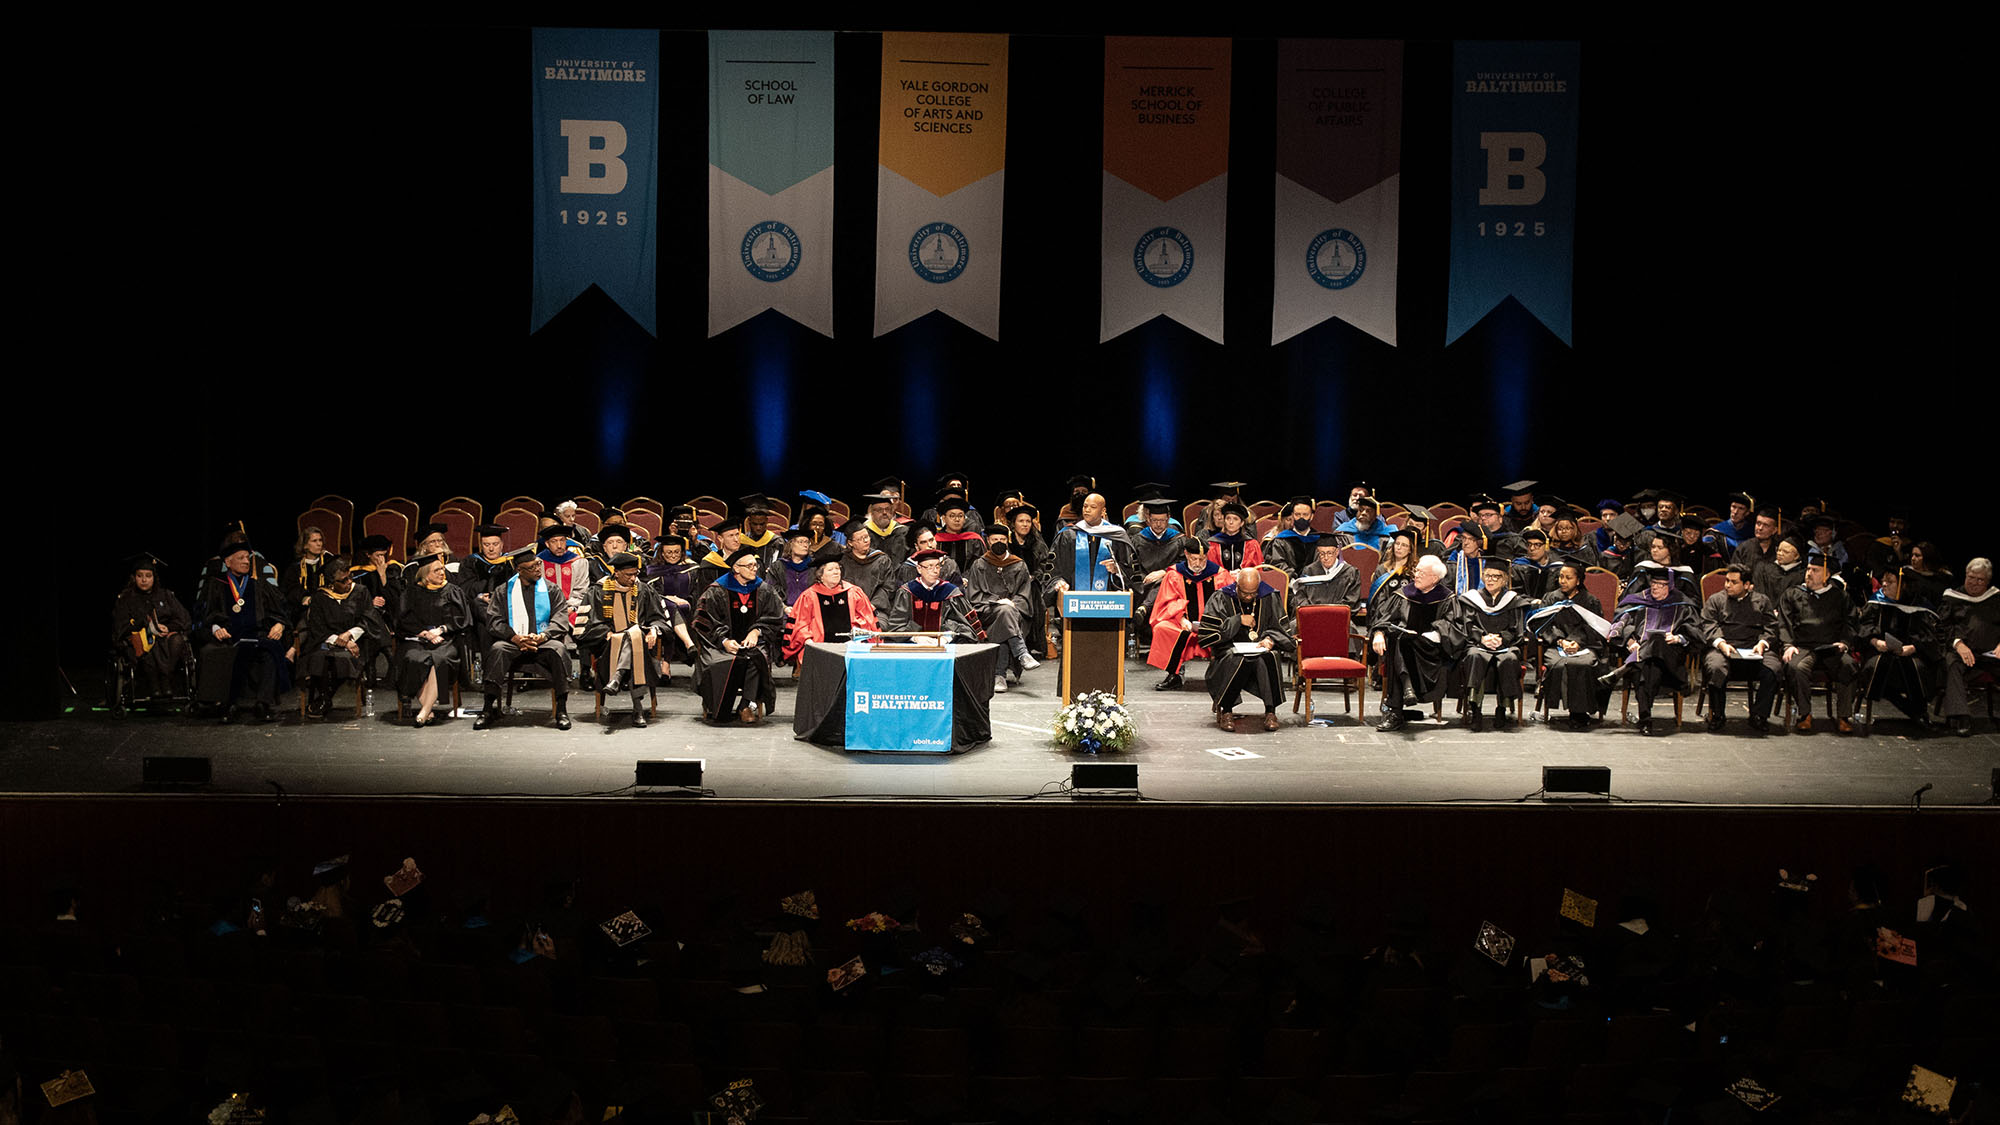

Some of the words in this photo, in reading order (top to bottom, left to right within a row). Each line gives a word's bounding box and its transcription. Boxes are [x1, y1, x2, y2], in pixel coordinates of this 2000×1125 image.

[556, 59, 617, 69] UNIVERSITY
[622, 61, 634, 69] OF
[545, 67, 646, 82] BALTIMORE
[1477, 72, 1538, 80] UNIVERSITY
[745, 80, 797, 91] SCHOOL
[900, 80, 929, 91] YALE
[934, 81, 988, 93] GORDON
[1139, 86, 1195, 97] MERRICK
[1465, 80, 1567, 93] BALTIMORE
[748, 94, 764, 104] OF
[767, 94, 795, 104] LAW
[1312, 87, 1368, 99] COLLEGE
[916, 94, 971, 106] COLLEGE
[1131, 99, 1184, 111] SCHOOL
[1186, 100, 1203, 111] OF
[1308, 101, 1325, 112] OF
[1327, 102, 1371, 113] PUBLIC
[904, 107, 921, 118] OF
[924, 108, 953, 119] ARTS
[956, 110, 983, 120] AND
[1138, 113, 1196, 124] BUSINESS
[1315, 115, 1364, 126] AFFAIRS
[914, 122, 972, 133] SCIENCES
[560, 119, 628, 195] B
[1479, 132, 1547, 206] B
[560, 210, 628, 226] 1925
[1478, 222, 1545, 237] 1925
[744, 225, 763, 268] University
[782, 226, 799, 268] Baltimore
[911, 226, 930, 269] University
[950, 227, 967, 270] Baltimore
[1137, 232, 1155, 273] University
[1175, 232, 1191, 274] Baltimore
[1310, 233, 1328, 275] University
[1348, 234, 1364, 275] Baltimore
[857, 695, 866, 704] B
[872, 701, 945, 710] BALTIMORE
